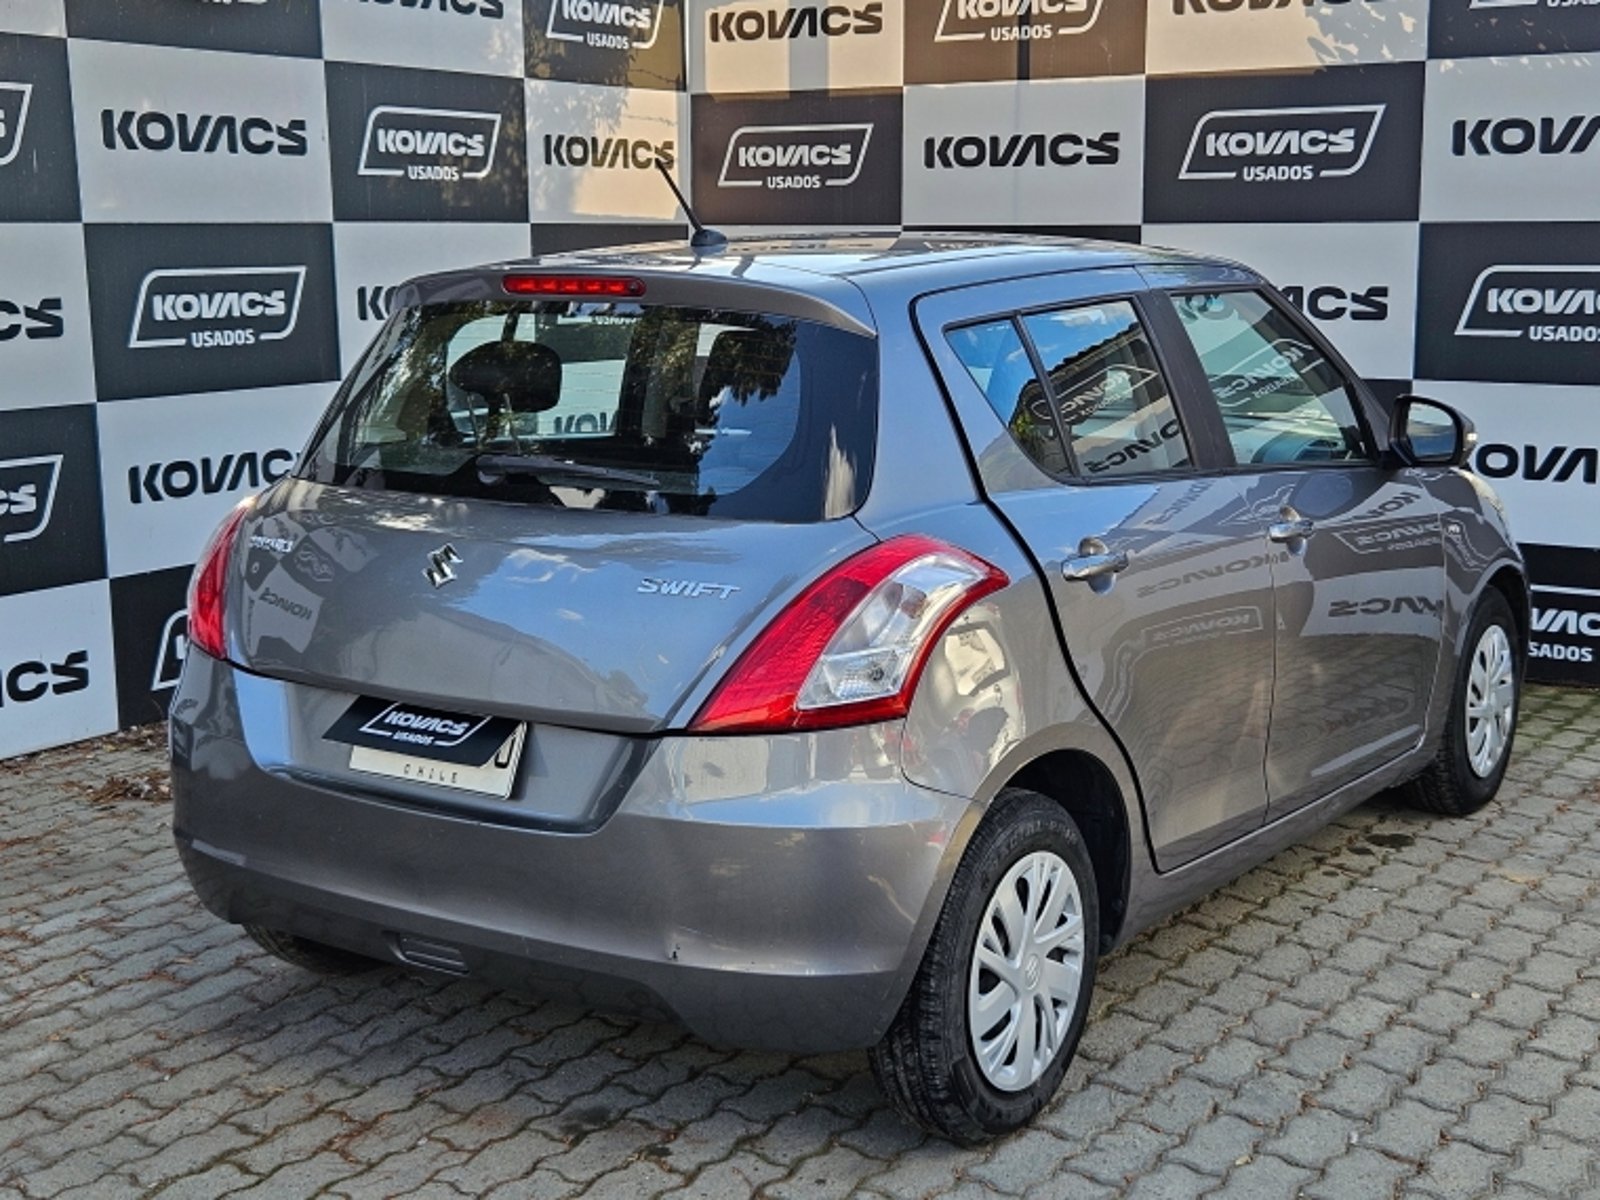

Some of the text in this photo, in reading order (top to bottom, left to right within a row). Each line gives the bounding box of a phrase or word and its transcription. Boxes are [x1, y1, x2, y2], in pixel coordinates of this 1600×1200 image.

[562, 0, 652, 29] KOVACS
[709, 2, 883, 42] KOVACS
[586, 32, 629, 49] USADOS
[990, 24, 1052, 41] USADOS
[102, 108, 308, 156] KOVACS
[376, 128, 486, 157] KOVACS
[1205, 127, 1356, 157] KOVACS
[543, 134, 675, 169] KOVACS
[738, 143, 852, 168] KOVACS
[924, 131, 1120, 169] KOVACS
[407, 165, 460, 181] USADOS
[767, 174, 821, 189] USADOS
[1242, 165, 1314, 182] USADOS
[152, 289, 287, 322] KOVACS
[1486, 287, 1600, 315] KOVA
[190, 329, 256, 348] USADOS
[128, 448, 300, 504] KOVAC
[1467, 444, 1599, 484] OVA
[637, 576, 741, 599] SWIFT
[0, 650, 89, 706] CS
[384, 710, 470, 736] KOVACS
[403, 763, 459, 784] CHILE
